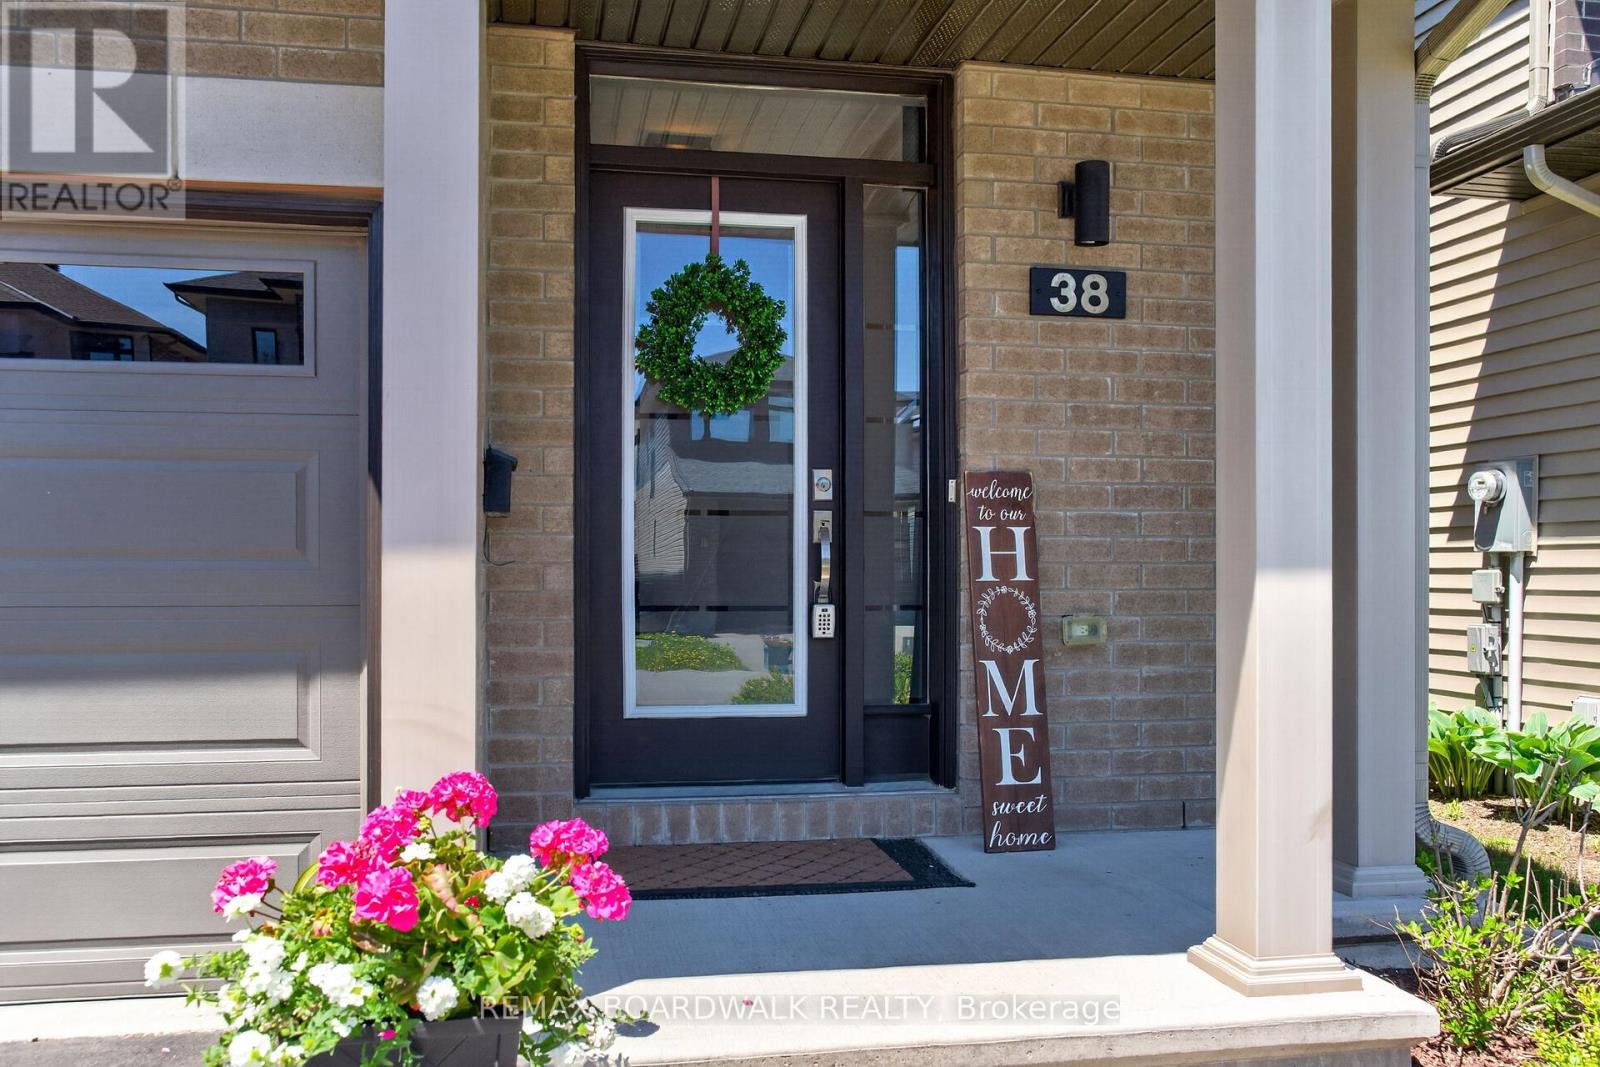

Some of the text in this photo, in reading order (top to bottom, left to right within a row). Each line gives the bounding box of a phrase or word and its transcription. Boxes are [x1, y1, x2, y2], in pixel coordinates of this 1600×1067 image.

[1049, 272, 1110, 314] 38
[966, 479, 1033, 501] welcome
[977, 504, 1027, 521] to our
[991, 794, 1047, 816] sweet
[989, 820, 1053, 848] home
